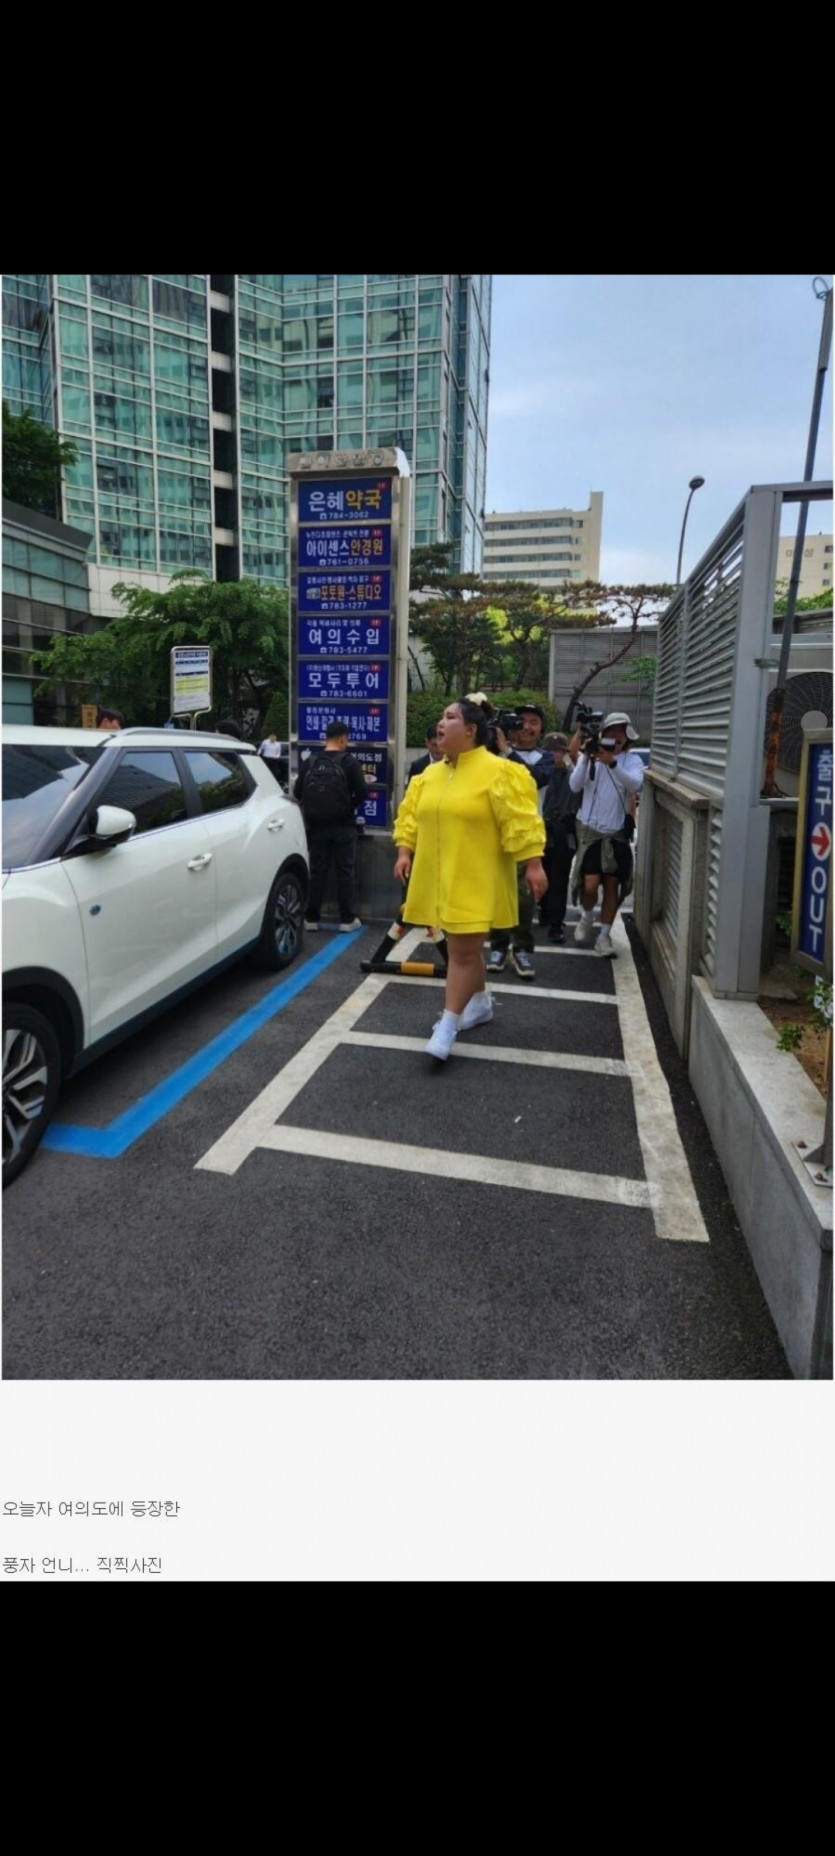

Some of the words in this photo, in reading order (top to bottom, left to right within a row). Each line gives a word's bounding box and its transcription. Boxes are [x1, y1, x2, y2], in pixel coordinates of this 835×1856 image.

[308, 489, 382, 512] 은혜약국
[327, 558, 370, 566] 761-0756
[329, 602, 367, 610] 783-1277
[308, 628, 380, 645] 여의수입
[328, 646, 368, 654] 783-5477
[308, 672, 380, 689] 모두투어
[815, 749, 833, 816] 출구
[809, 866, 827, 952] OUT
